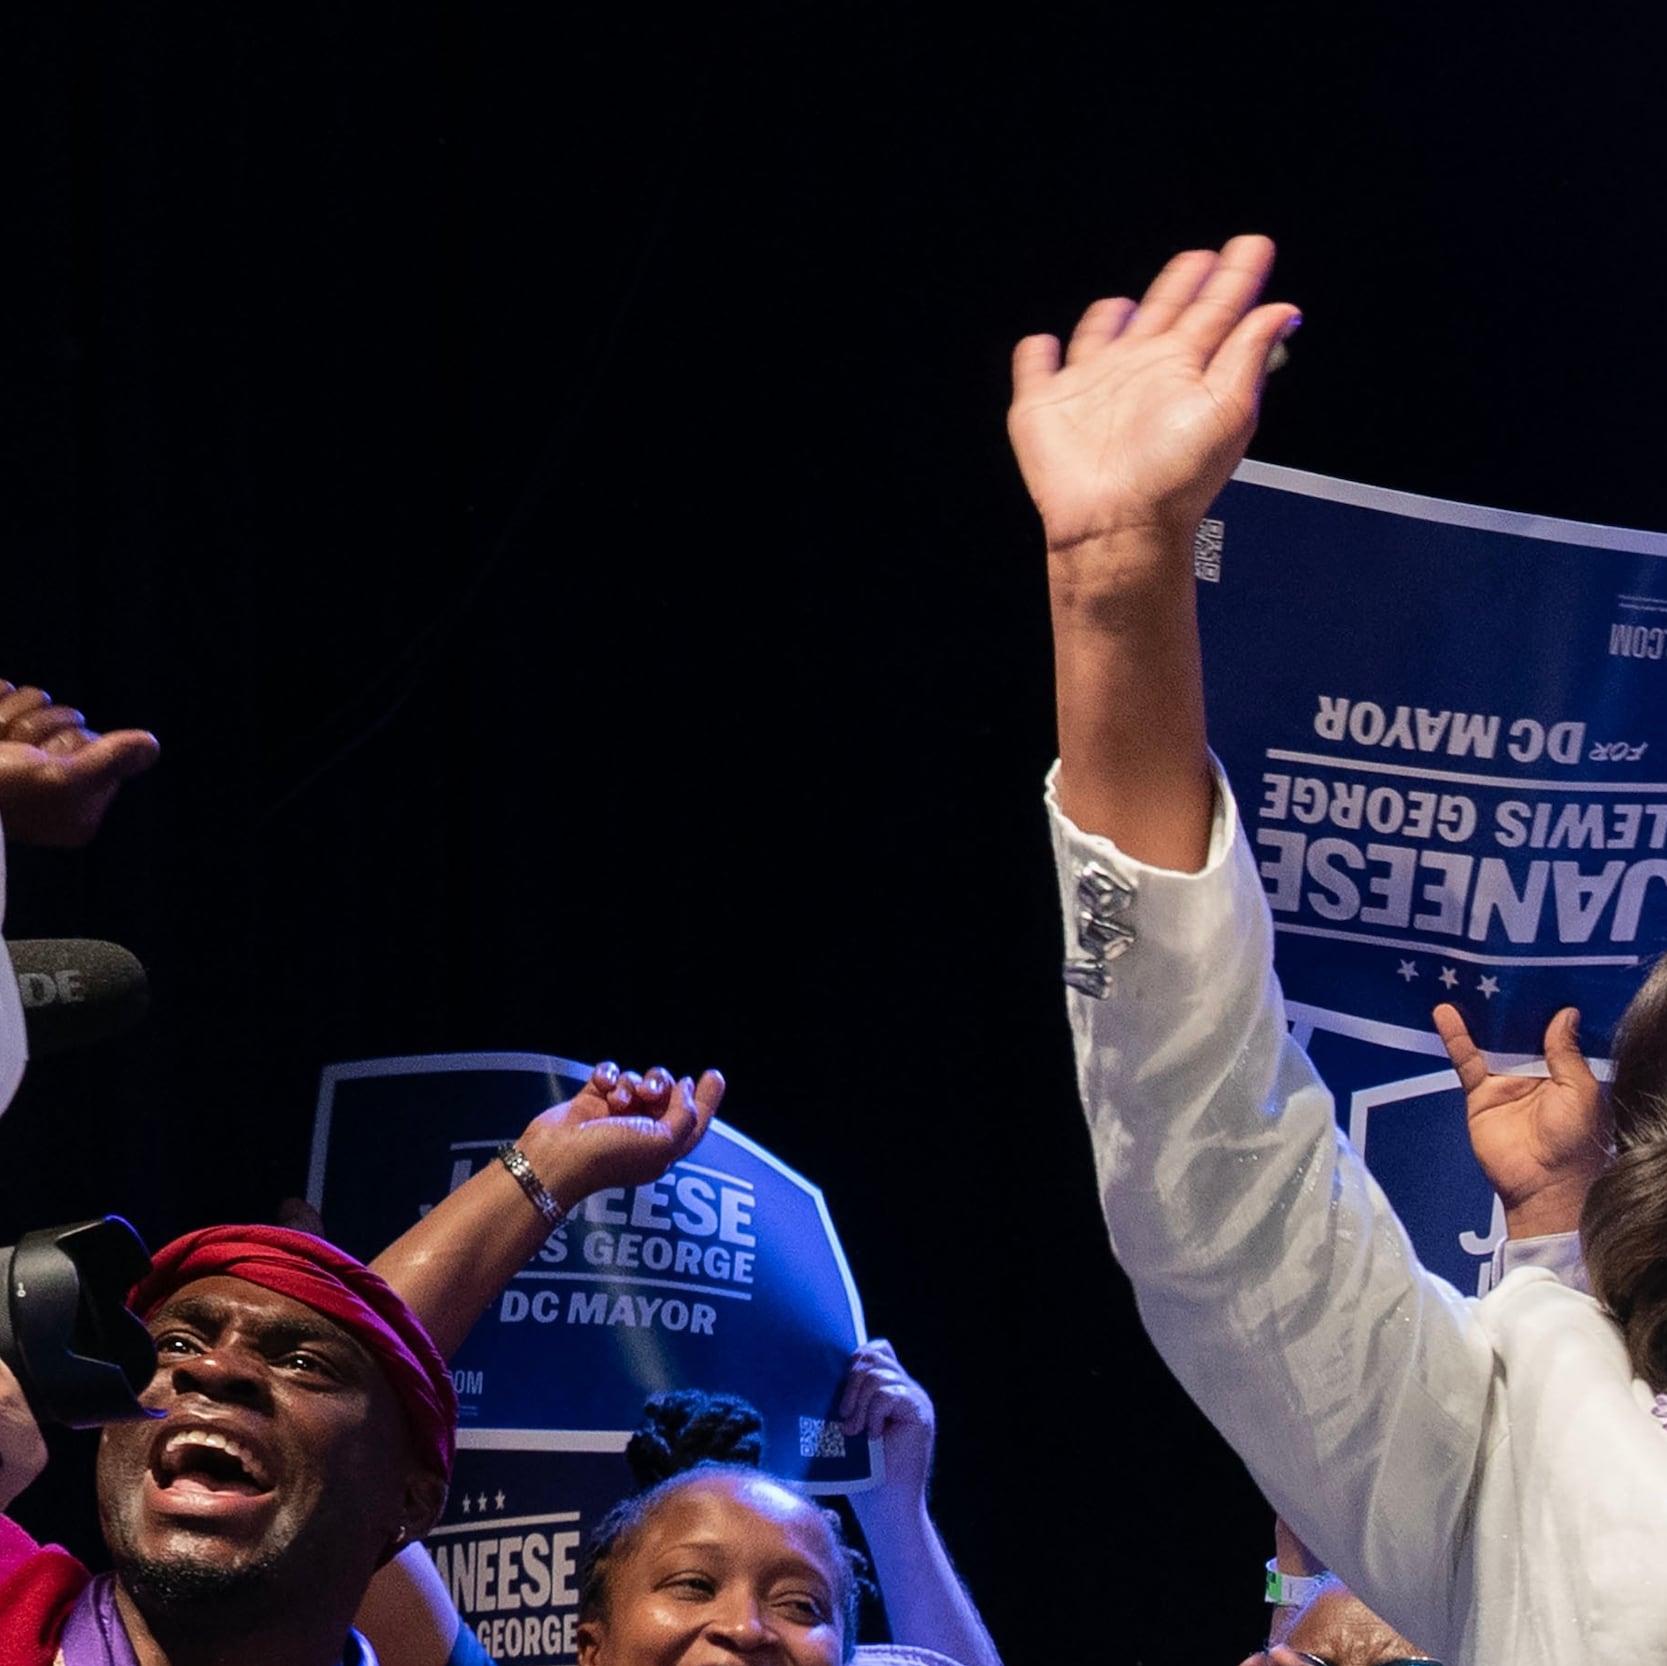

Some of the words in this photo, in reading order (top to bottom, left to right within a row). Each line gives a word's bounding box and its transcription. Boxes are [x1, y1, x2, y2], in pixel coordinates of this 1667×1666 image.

[1313, 696, 1499, 760] MAYOR
[1509, 719, 1586, 765] DC
[1590, 740, 1648, 762] FOR
[1259, 773, 1477, 844] GEORGE
[18, 969, 85, 1009] DE
[584, 1233, 755, 1285] GEORGE
[500, 1289, 560, 1325] DC
[568, 1291, 718, 1337] MAYOR
[428, 1530, 580, 1613] ANEESE
